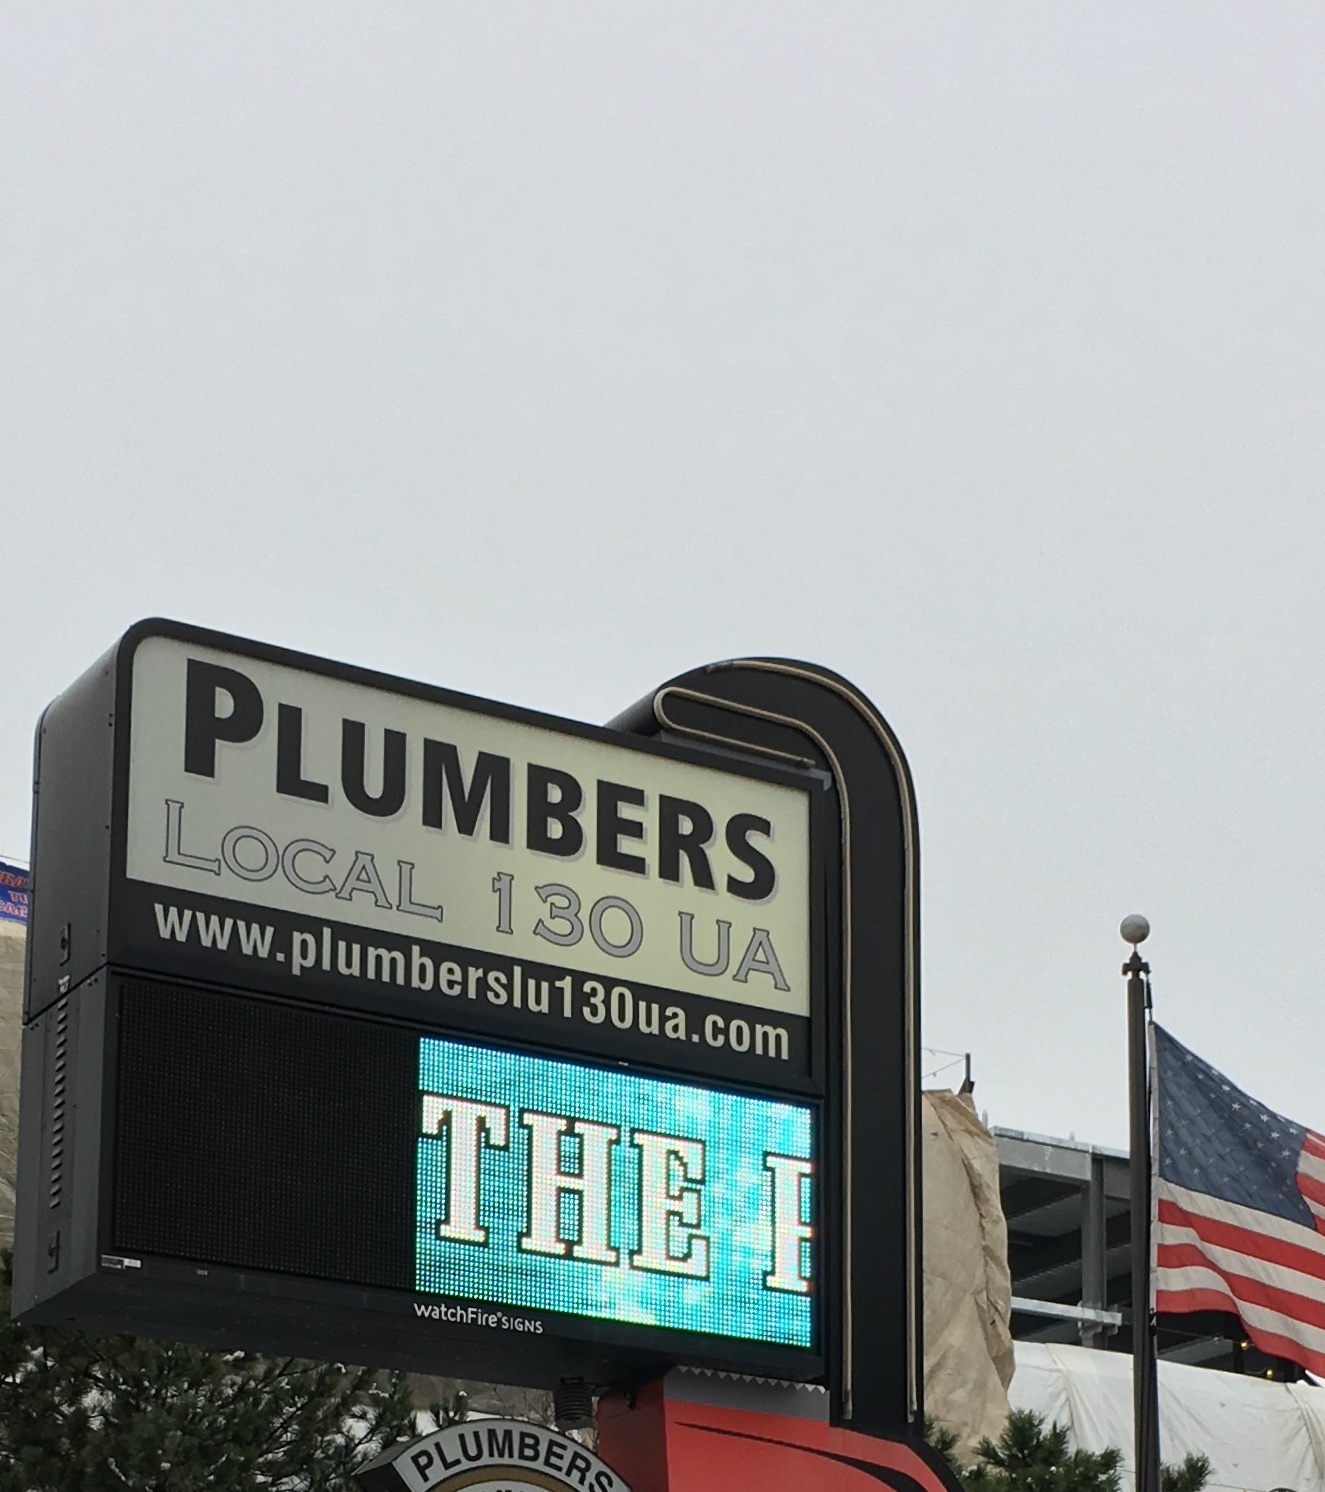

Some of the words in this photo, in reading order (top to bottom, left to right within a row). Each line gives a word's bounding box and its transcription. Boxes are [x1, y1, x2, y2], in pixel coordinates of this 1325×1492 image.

[182, 658, 777, 902] PLUMBERS
[153, 901, 791, 1062] www.plumberslu130ua.com
[162, 799, 444, 923] LOCAL
[492, 871, 645, 959] 130
[679, 912, 793, 993] UA
[421, 1093, 710, 1279] THE
